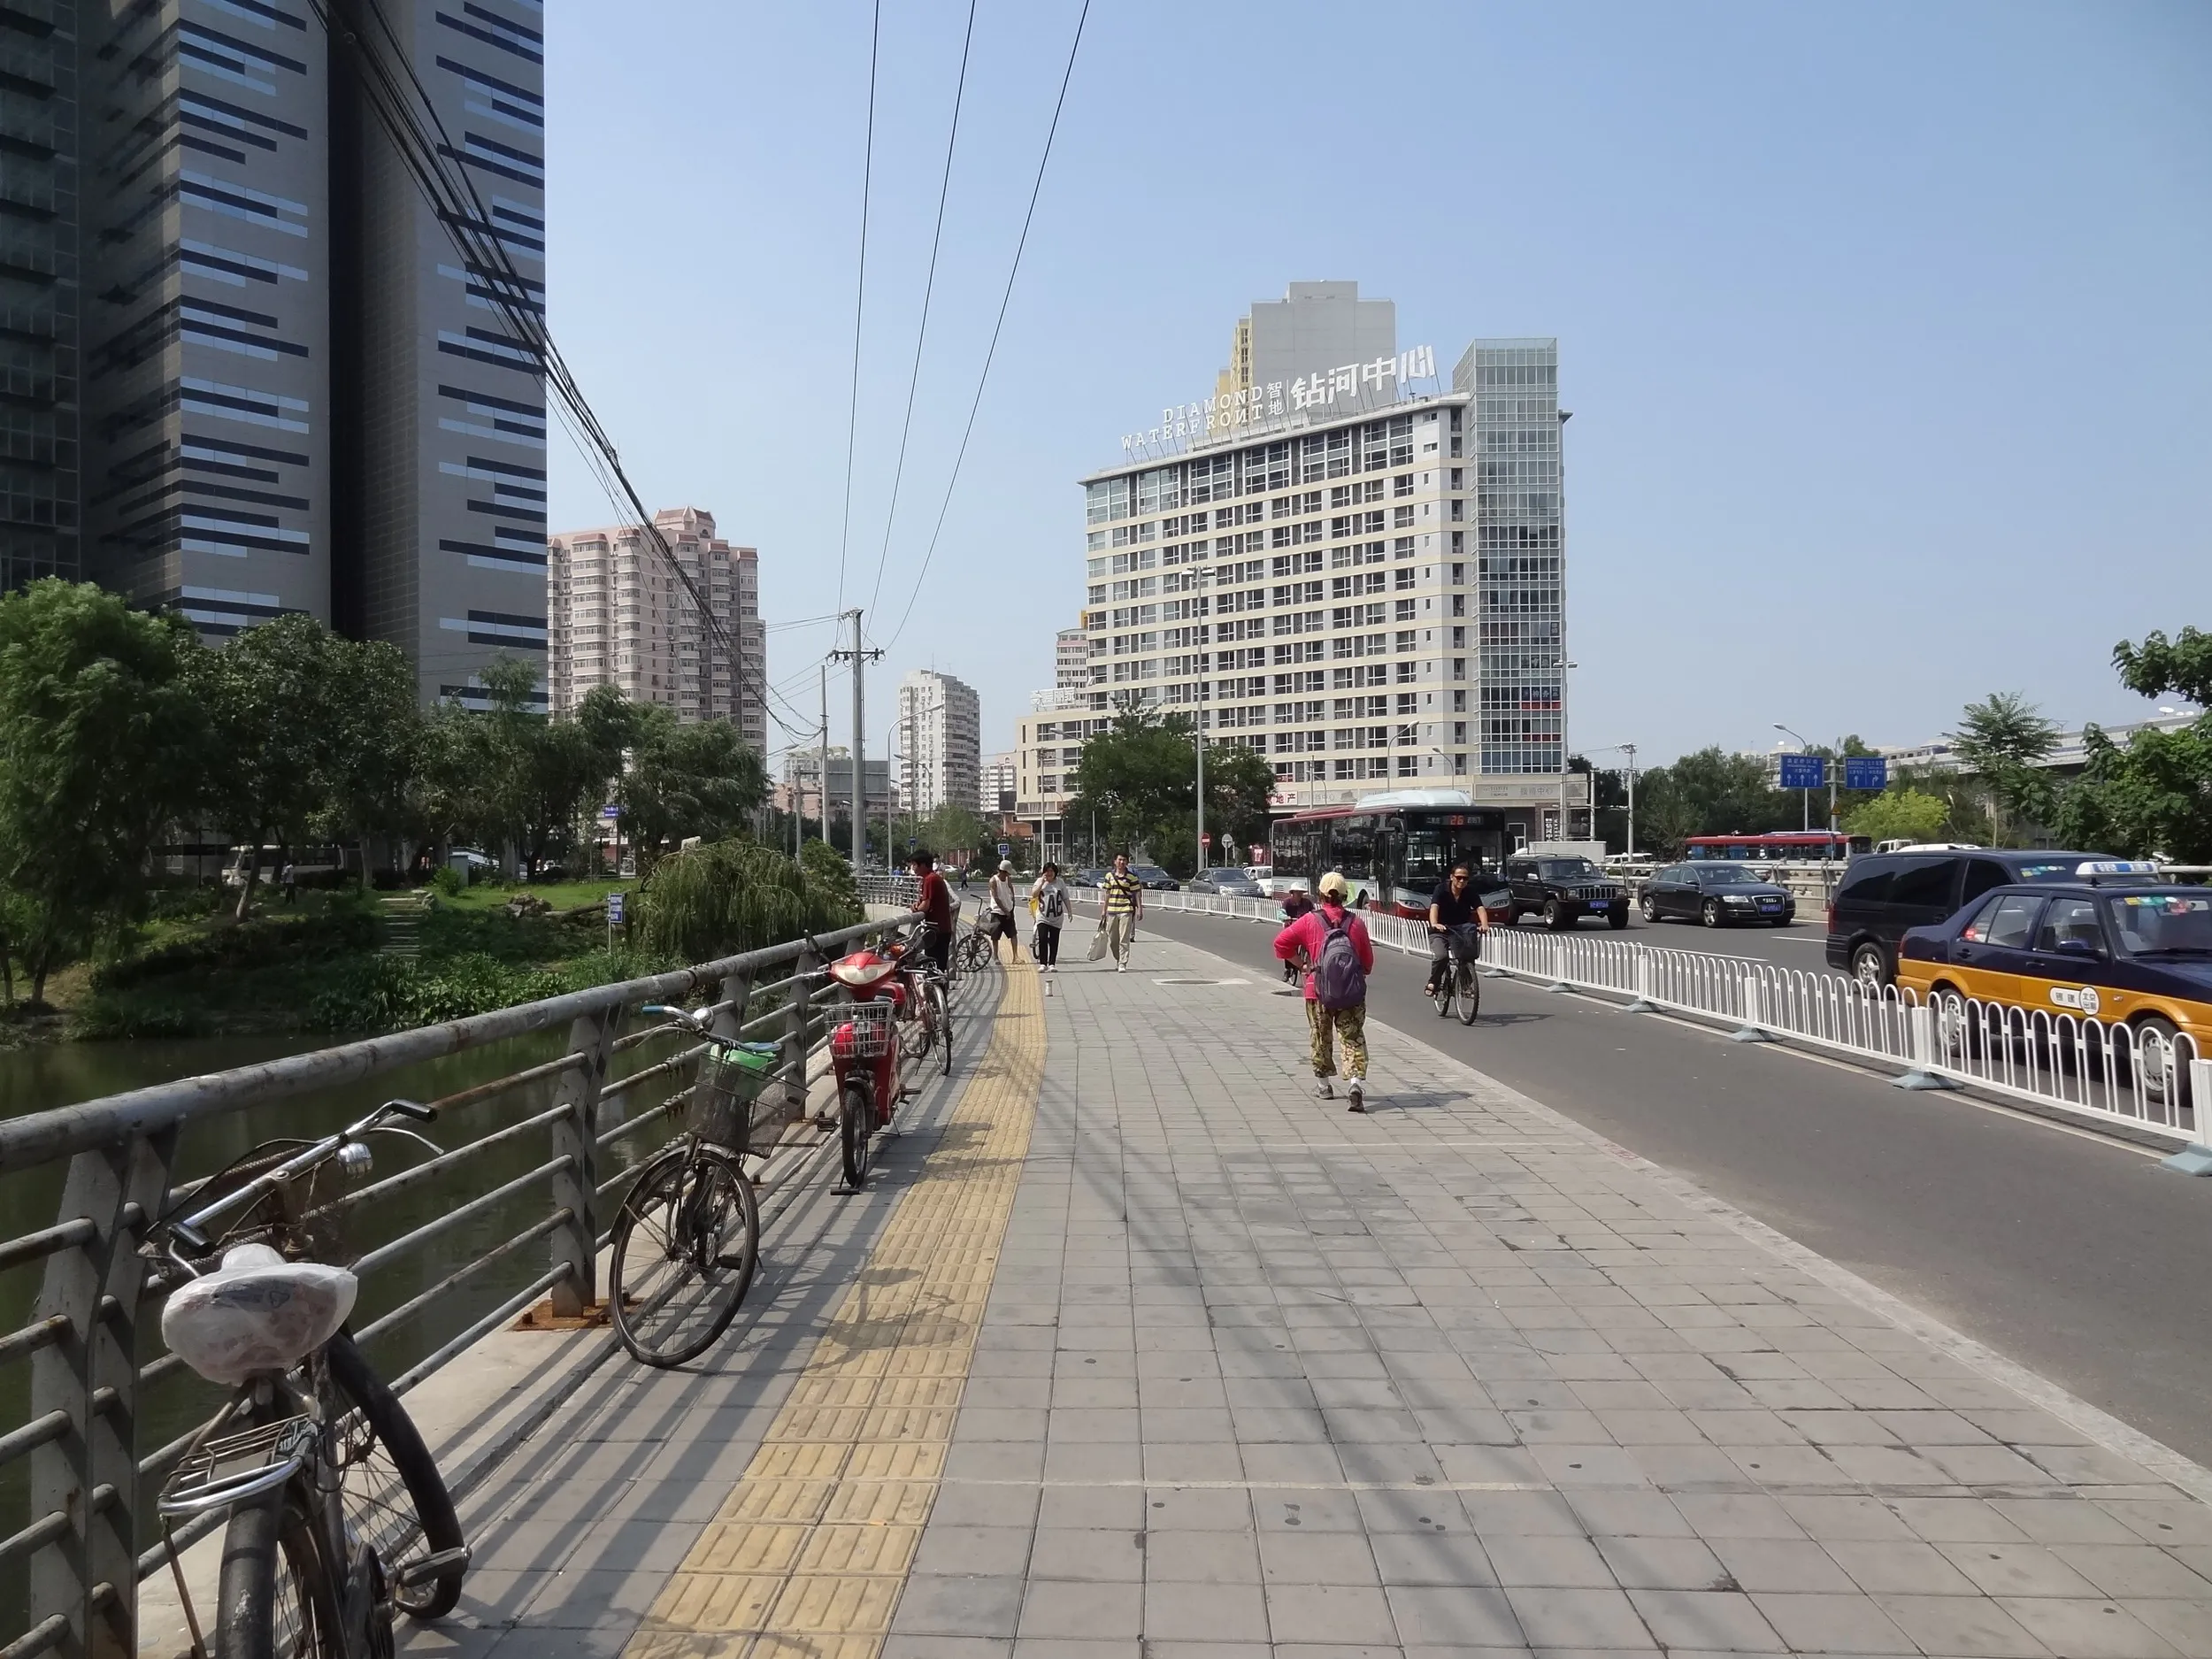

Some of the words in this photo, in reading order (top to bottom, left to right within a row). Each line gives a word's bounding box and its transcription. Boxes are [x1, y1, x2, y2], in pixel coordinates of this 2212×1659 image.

[1290, 344, 1436, 411] 钻河中心
[1162, 386, 1263, 424] DIAMOND
[1266, 380, 1285, 417] 智地
[1449, 815, 1464, 826] 26
